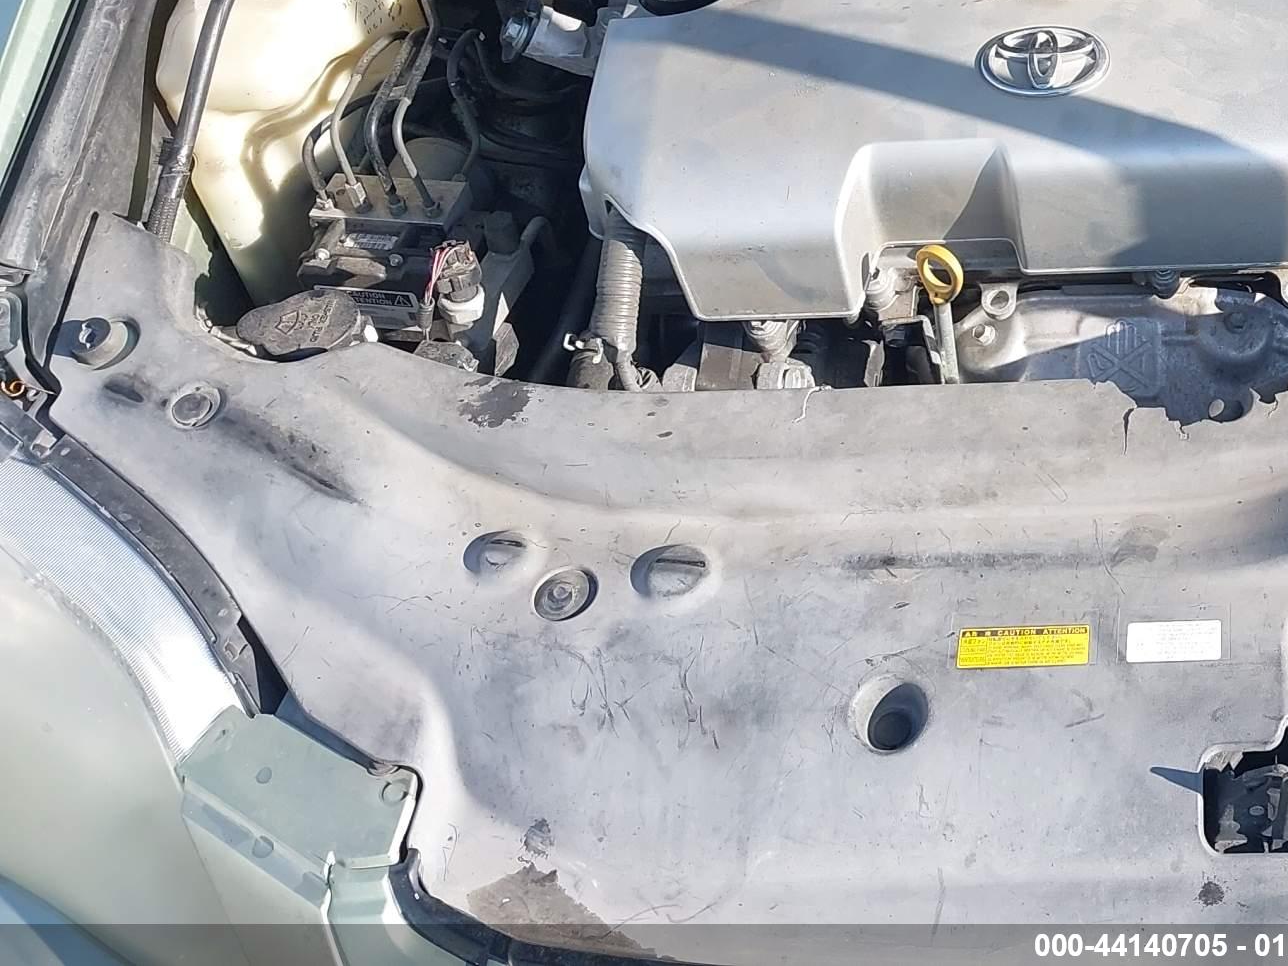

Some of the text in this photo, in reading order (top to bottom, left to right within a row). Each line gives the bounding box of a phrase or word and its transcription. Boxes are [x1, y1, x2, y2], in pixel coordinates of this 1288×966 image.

[352, 291, 386, 299] AUTION
[998, 628, 1036, 636] CAUTION
[1043, 627, 1085, 635] ATTENTION
